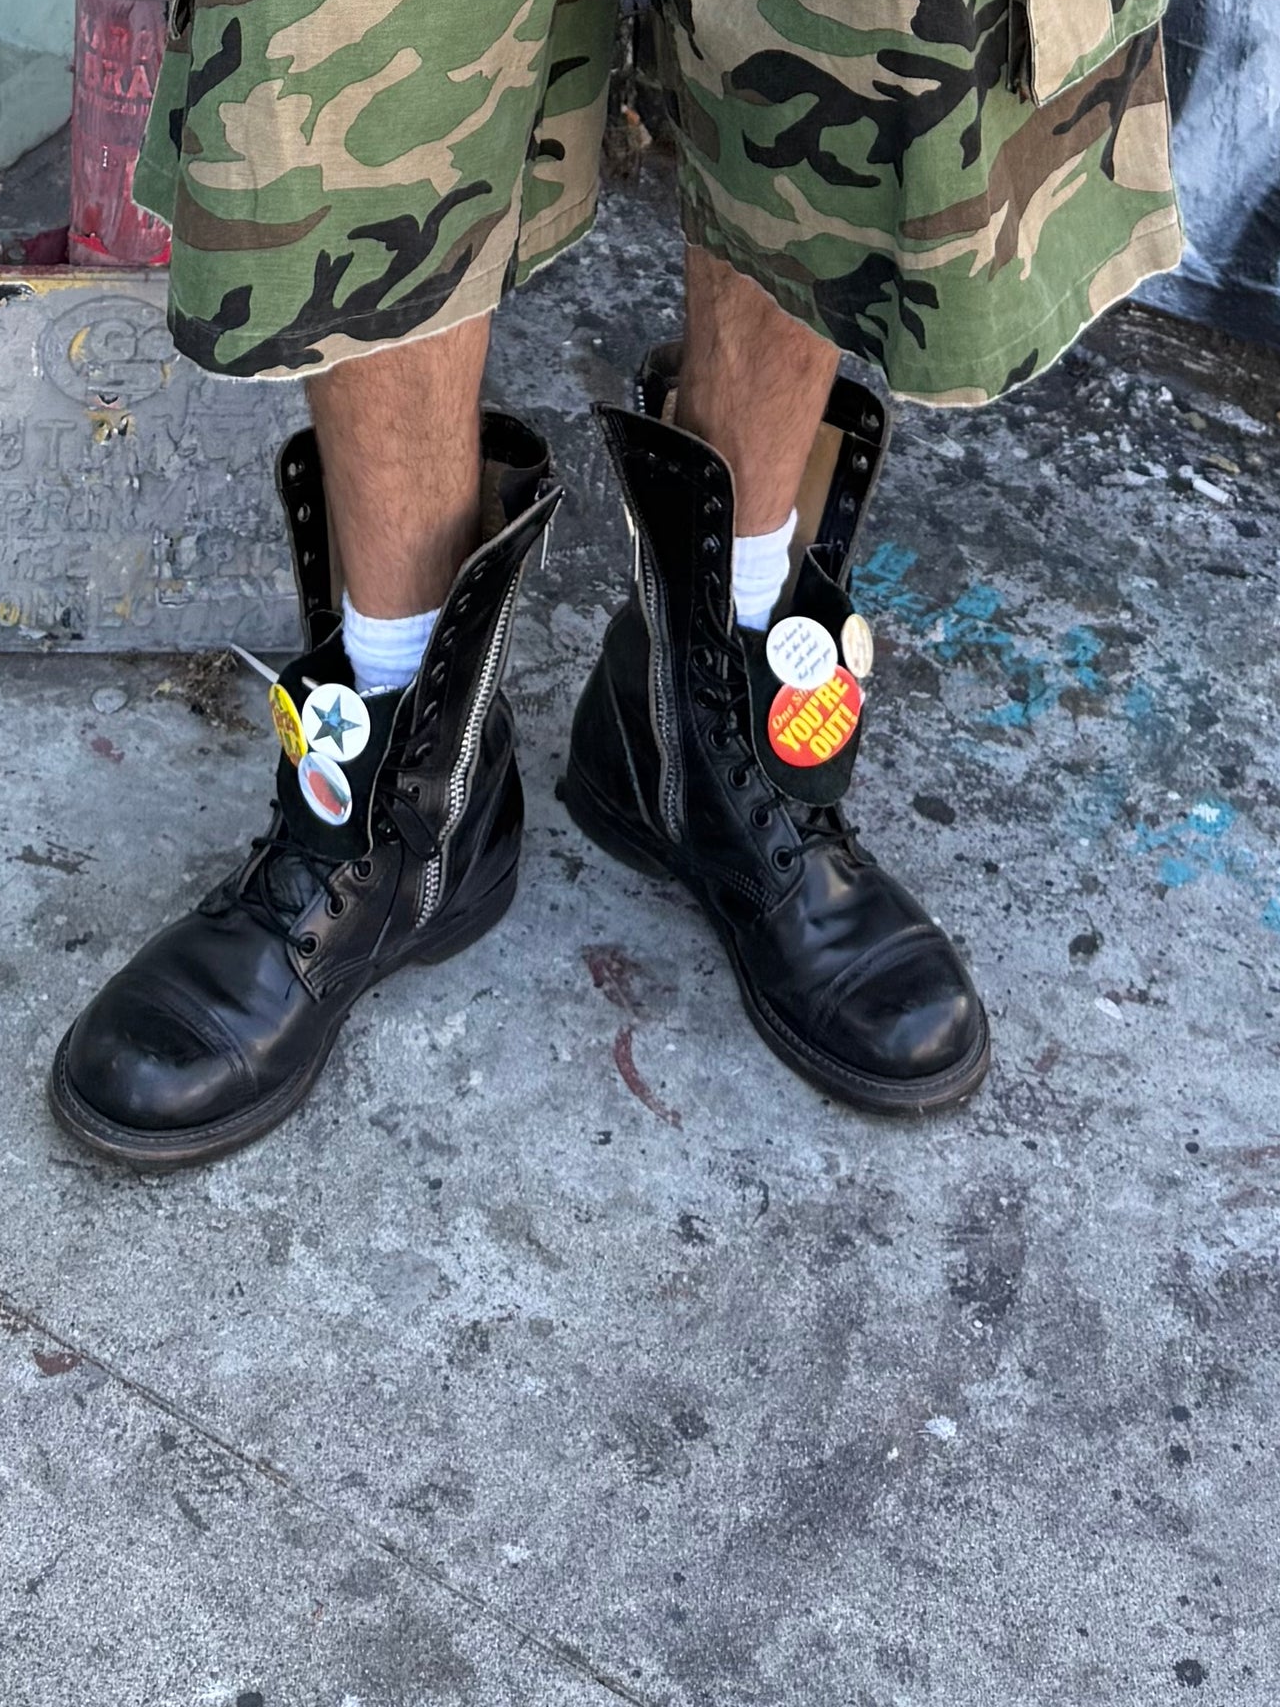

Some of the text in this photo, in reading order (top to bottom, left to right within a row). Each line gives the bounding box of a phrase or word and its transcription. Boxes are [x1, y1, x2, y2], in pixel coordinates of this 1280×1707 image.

[772, 704, 794, 729] One
[777, 676, 849, 752] YOU'RE
[809, 703, 858, 760] OUT!
